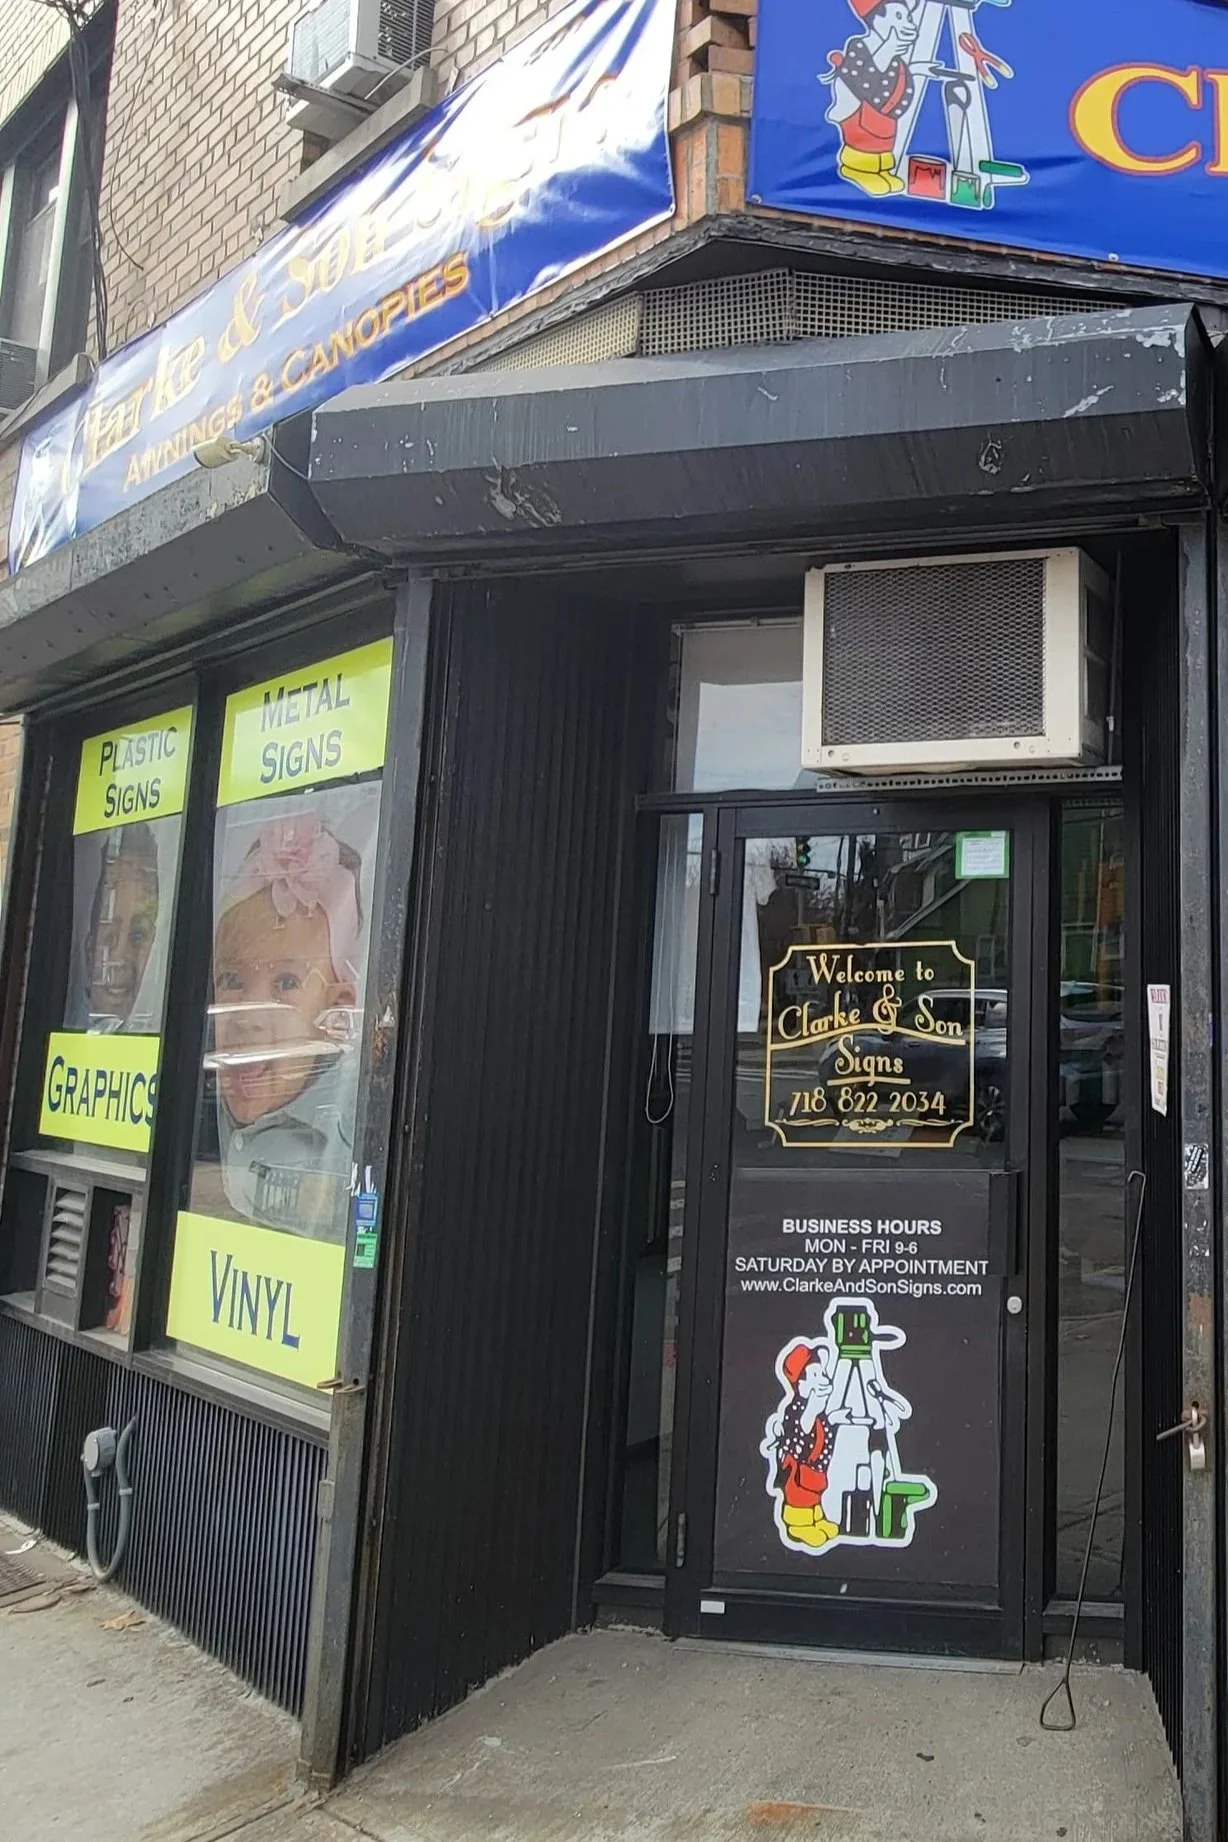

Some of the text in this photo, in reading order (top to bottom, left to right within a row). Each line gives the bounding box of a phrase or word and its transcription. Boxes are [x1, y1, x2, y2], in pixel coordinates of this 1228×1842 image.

[279, 250, 470, 395] CANOPIES
[260, 672, 351, 733] METAL
[99, 726, 178, 776] PLASTIC
[259, 730, 343, 784] SIGNS
[104, 778, 161, 818] SIGNS
[807, 953, 905, 985] Welcome
[916, 961, 935, 982] to
[778, 984, 963, 1039] Clarke & Son
[834, 1035, 904, 1087] Signs
[789, 1087, 946, 1116] 718 822 2034
[782, 1218, 942, 1235] BUSINESS HOURS
[805, 1239, 846, 1254] MON
[861, 1240, 890, 1254] FRI
[895, 1241, 918, 1255] 9-6
[735, 1257, 989, 1276] SATURDAY BY APPOINTMENT
[741, 1277, 982, 1297] www.ClarkeAndSonSigns.com
[210, 1250, 301, 1352] VINYL
